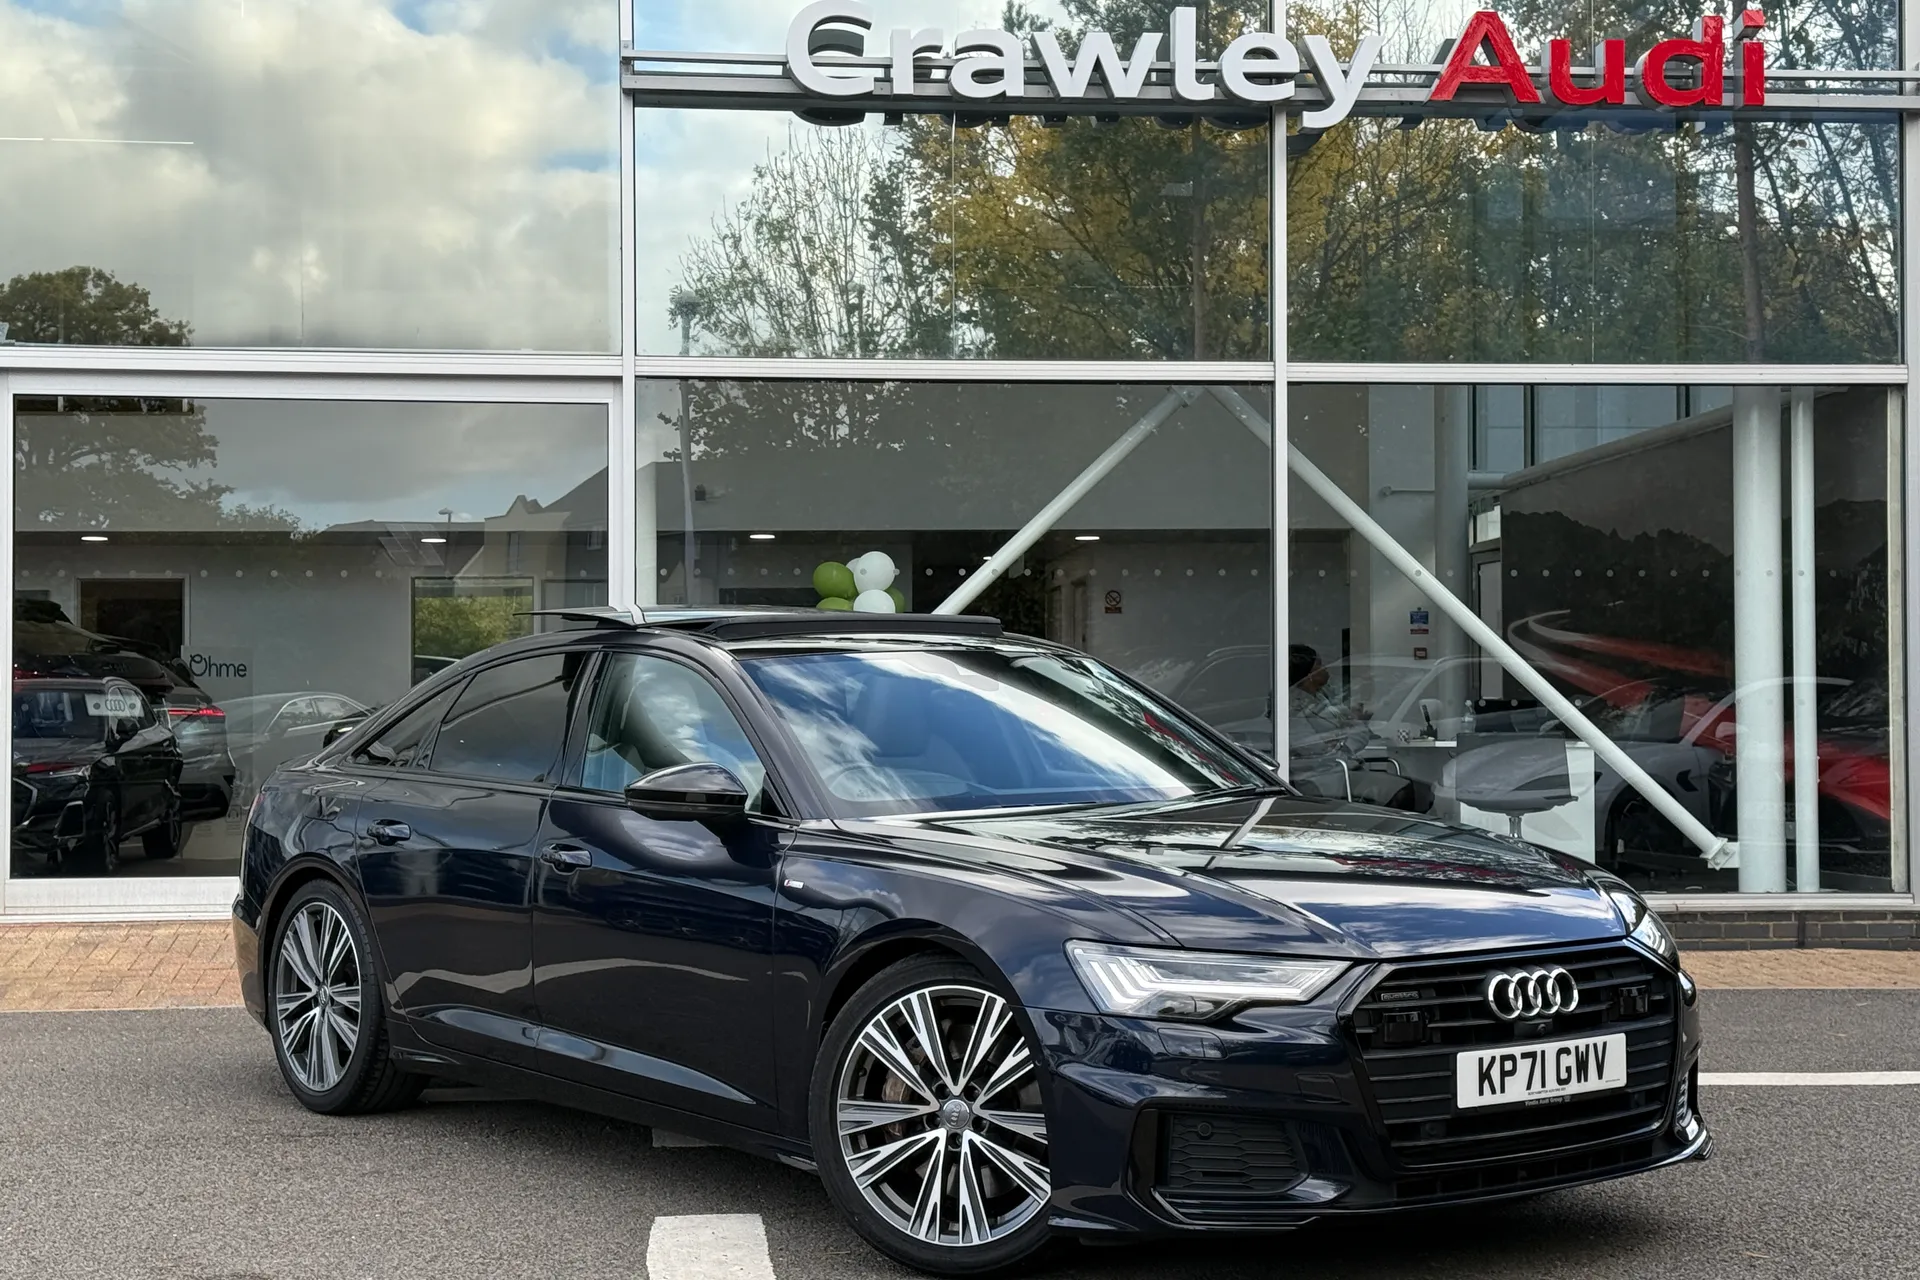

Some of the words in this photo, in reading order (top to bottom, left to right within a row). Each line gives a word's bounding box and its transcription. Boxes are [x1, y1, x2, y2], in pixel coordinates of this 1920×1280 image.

[785, 0, 1384, 129] Crawley
[1426, 10, 1765, 106] Audi
[190, 654, 247, 678] Ohme
[1478, 1049, 1546, 1097] KP71
[1556, 1040, 1608, 1087] GWV
